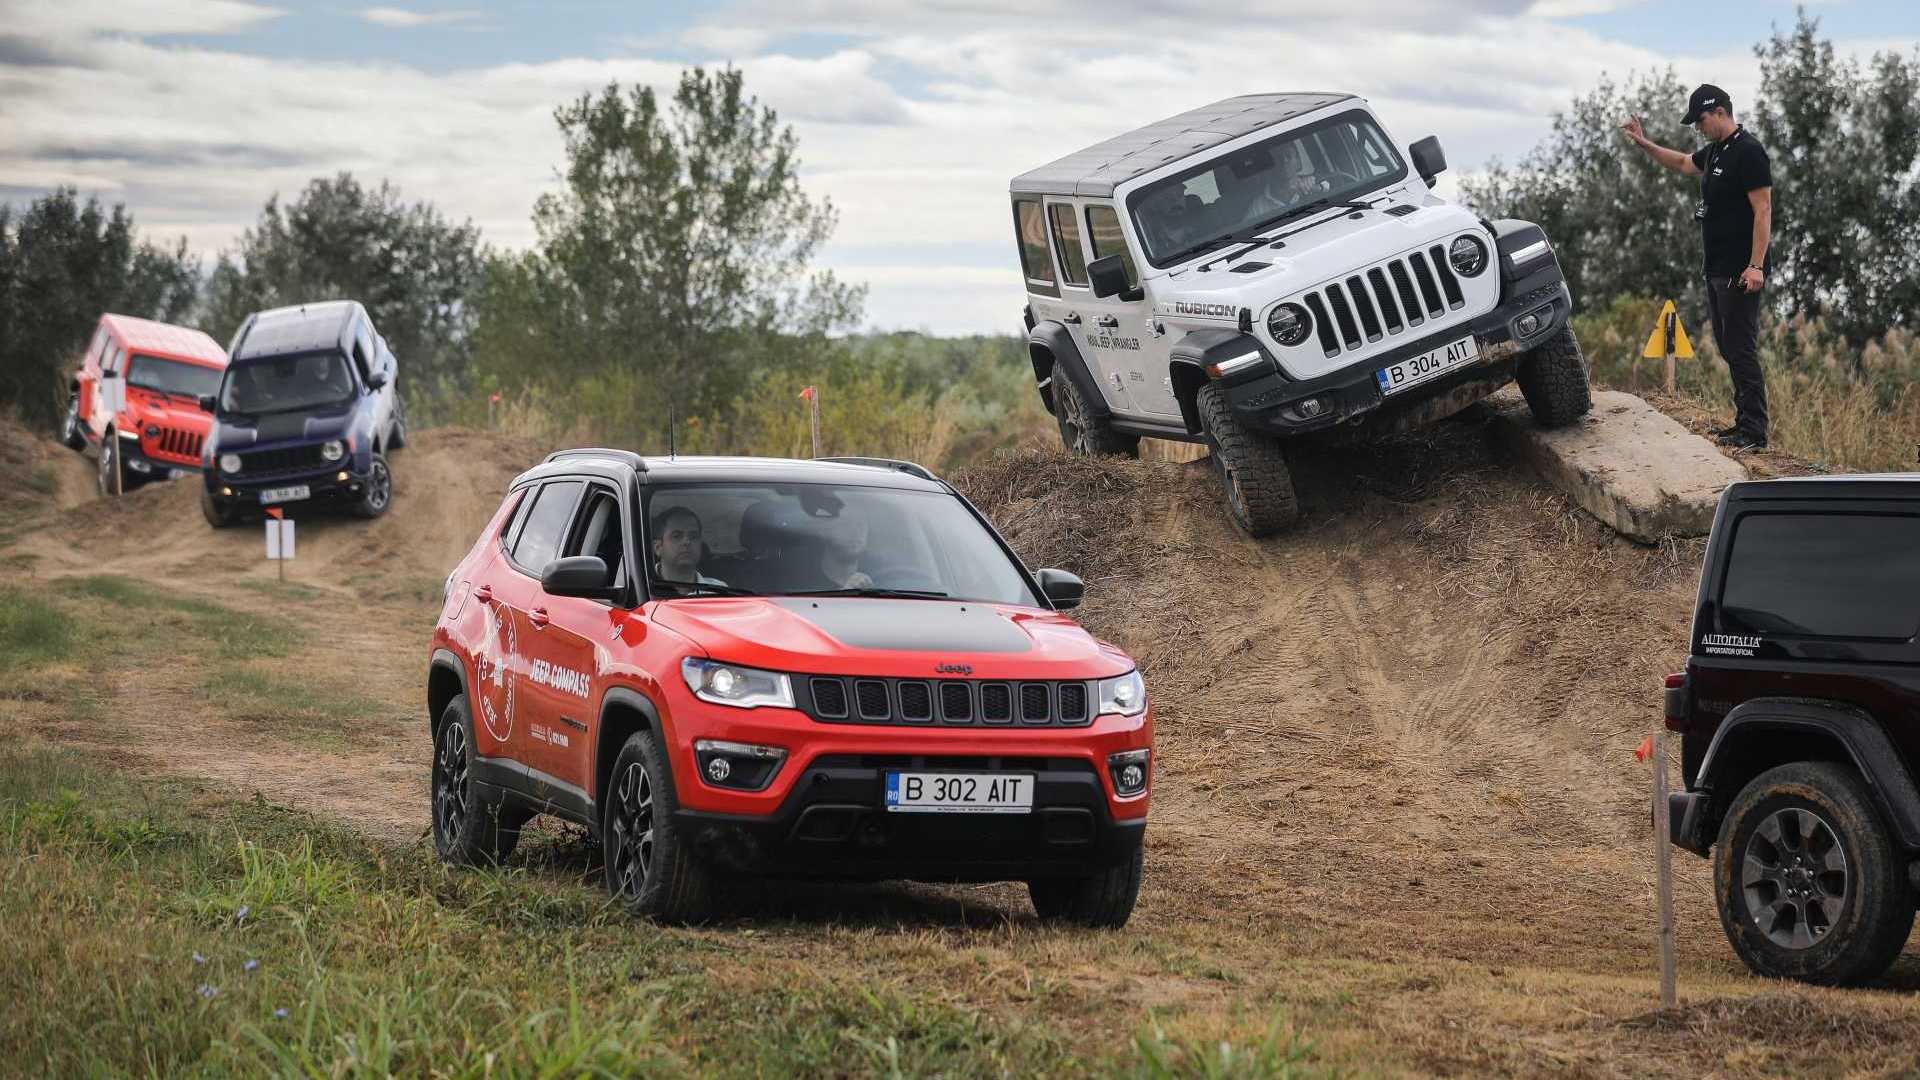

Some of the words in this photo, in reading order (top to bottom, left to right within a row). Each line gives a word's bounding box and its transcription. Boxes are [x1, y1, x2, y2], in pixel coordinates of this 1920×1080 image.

[1175, 301, 1237, 317] RUBICON
[1390, 366, 1405, 384] B
[1409, 353, 1440, 377] 304
[1447, 340, 1468, 364] AIT
[1701, 633, 1760, 647] AUTOITALIA
[1705, 646, 1736, 655] IMPORTATOR
[1736, 648, 1754, 656] OFICIAL
[934, 661, 973, 676] Jeep
[529, 657, 551, 685] JEEP
[550, 664, 591, 699] COMPASS
[887, 790, 899, 801] RO
[906, 777, 923, 801] B
[933, 778, 977, 802] 302
[987, 778, 1022, 802] AIT
